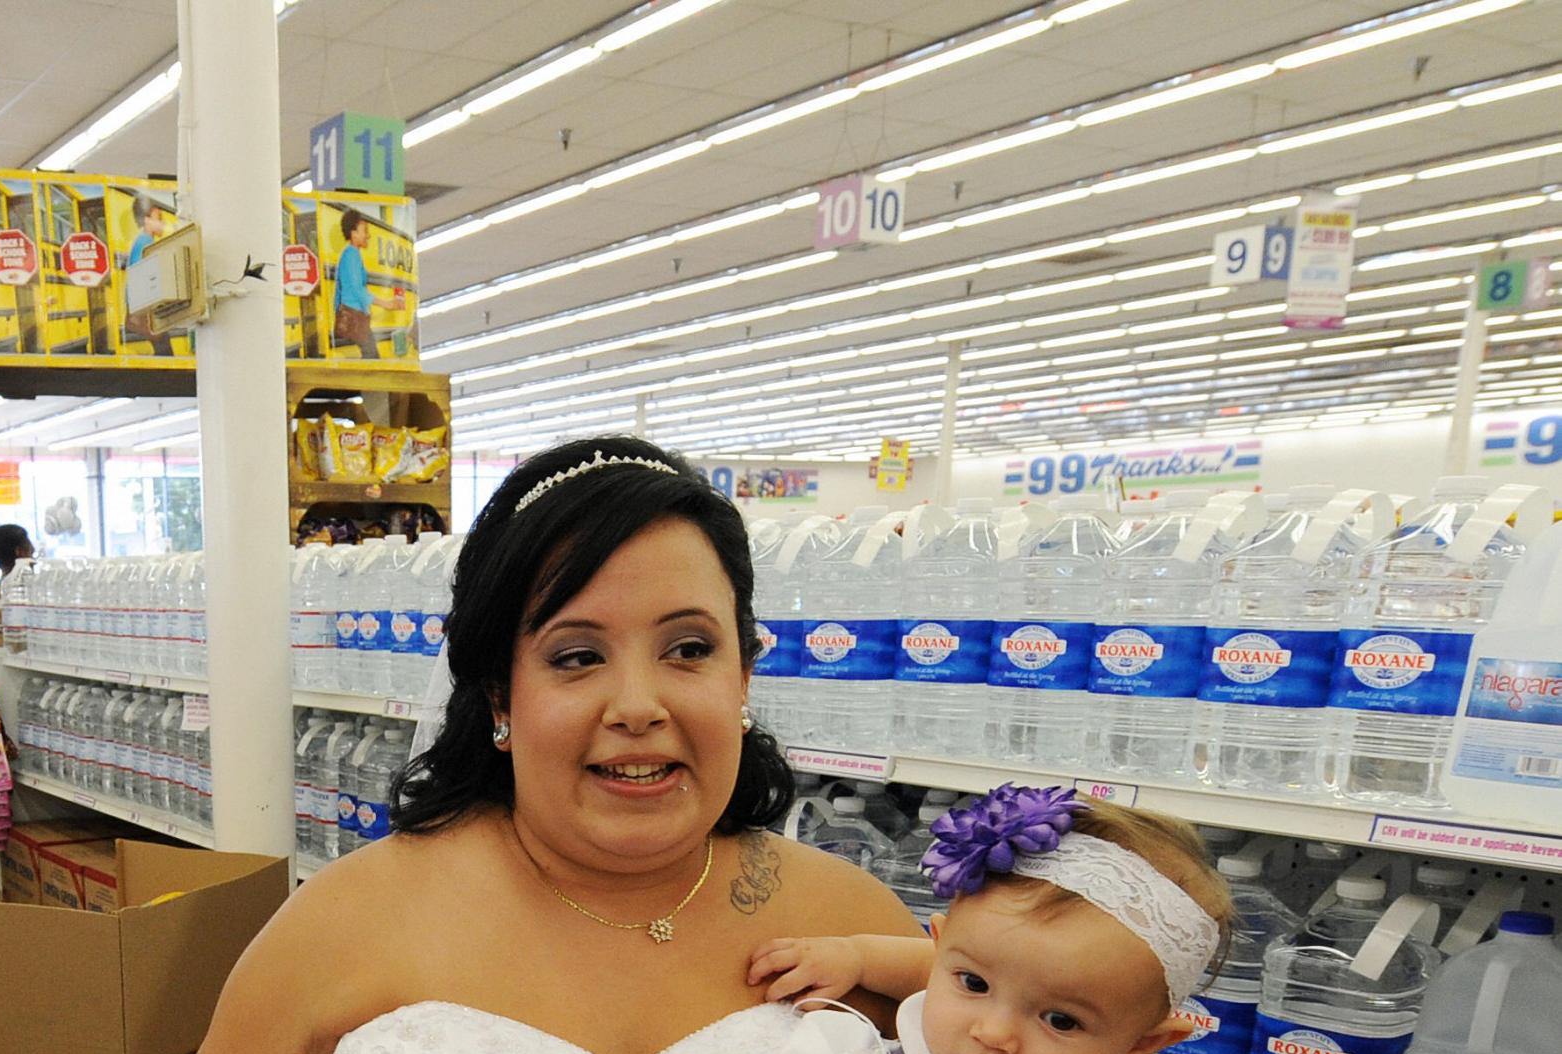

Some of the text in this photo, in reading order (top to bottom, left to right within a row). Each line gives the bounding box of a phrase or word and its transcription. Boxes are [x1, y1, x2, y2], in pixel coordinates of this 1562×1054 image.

[312, 126, 337, 188] 11
[353, 127, 395, 182] 11
[817, 190, 857, 239] 10
[865, 187, 900, 233] 10
[70, 241, 88, 250] BACK
[377, 237, 414, 274] LOAD
[1225, 238, 1248, 274] 9
[1266, 233, 1288, 274] 9
[1489, 269, 1514, 303] 8
[1028, 454, 1086, 496] 99
[809, 635, 853, 647] ROXANE
[904, 635, 956, 649] ROXANE
[1005, 639, 1062, 653] ROXANE
[1098, 643, 1158, 658] ROXANE
[1217, 650, 1286, 665] ROXANE
[1349, 652, 1429, 670] ROXANE
[1382, 824, 1398, 836] CRV
[1400, 828, 1415, 839] will
[1417, 830, 1428, 840] be
[1429, 831, 1456, 844] added
[1457, 836, 1469, 846] on
[1470, 837, 1482, 848] all
[1483, 839, 1529, 854] applicable
